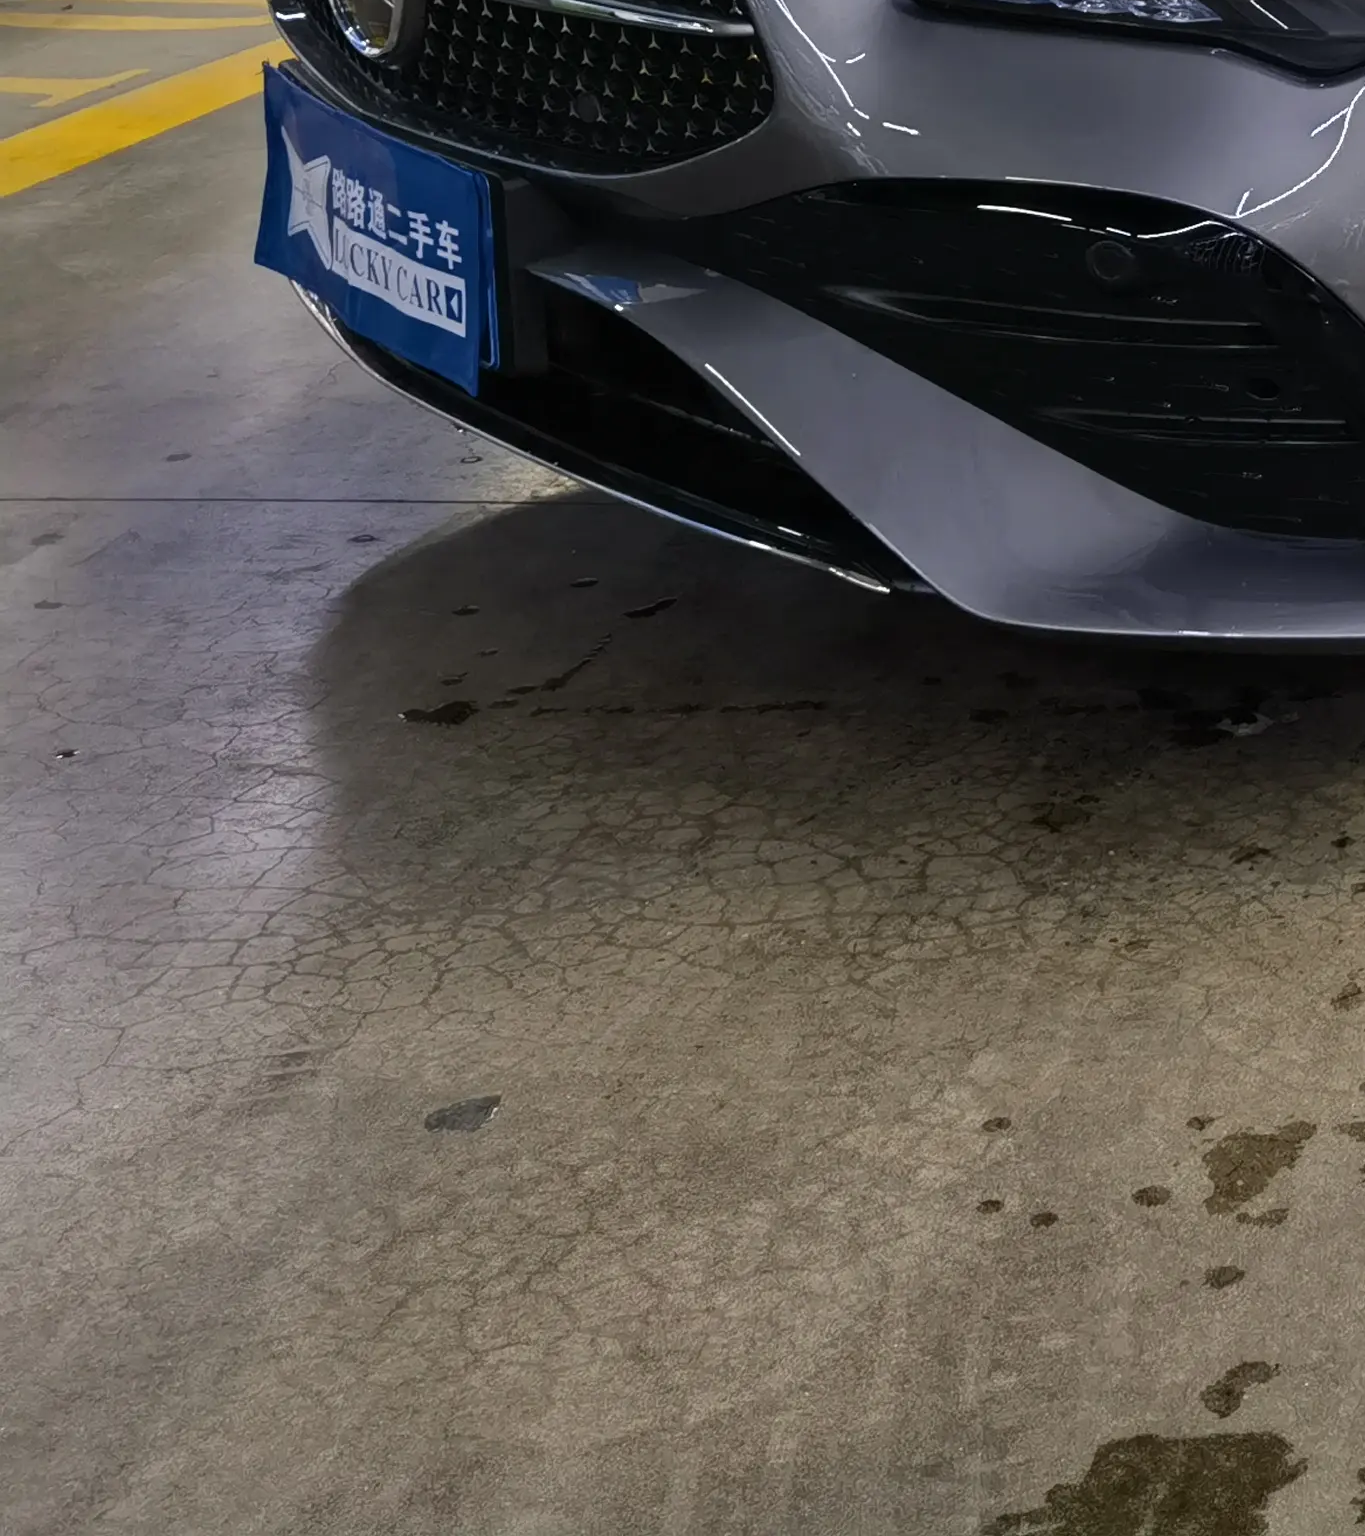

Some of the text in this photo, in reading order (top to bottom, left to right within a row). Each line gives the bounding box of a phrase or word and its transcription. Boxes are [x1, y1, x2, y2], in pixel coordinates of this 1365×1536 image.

[332, 167, 463, 270] 路路通二手车
[335, 227, 444, 316] LUCKY CAR
